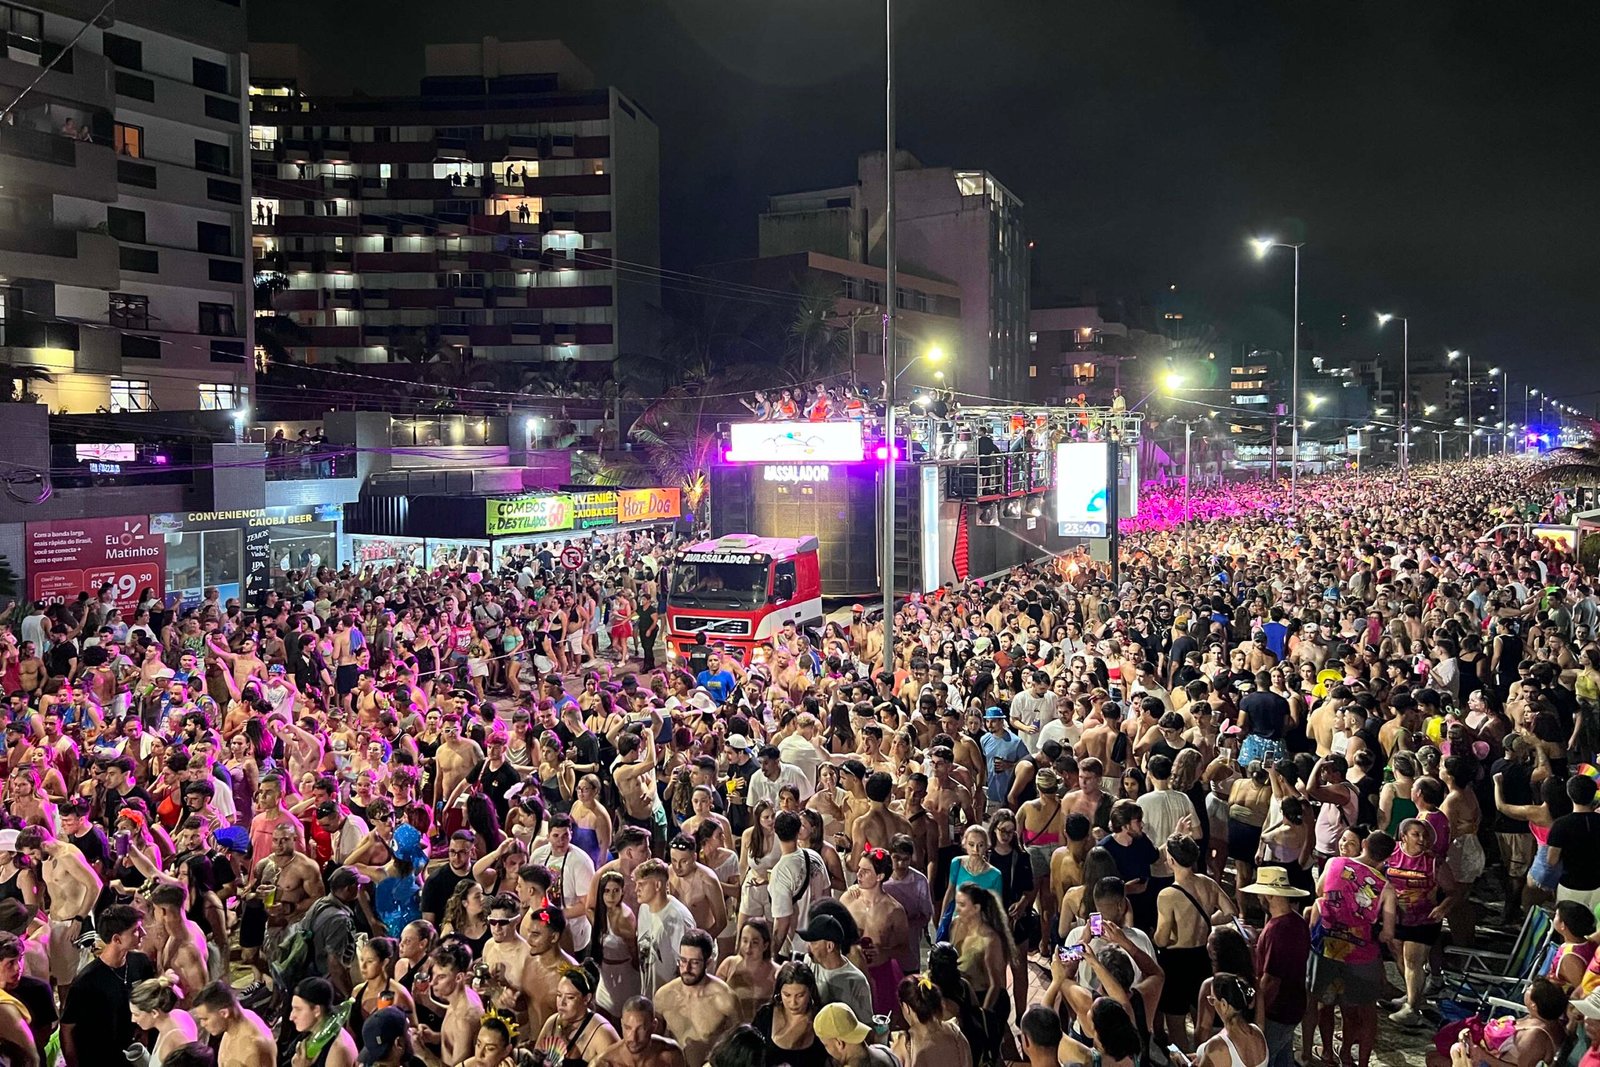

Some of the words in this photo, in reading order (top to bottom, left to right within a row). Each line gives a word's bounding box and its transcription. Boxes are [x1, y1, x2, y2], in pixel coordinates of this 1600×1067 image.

[497, 501, 546, 516] COMBOS
[188, 509, 266, 521] CONVENIENCIA
[249, 517, 286, 526] CAIOBA
[288, 514, 312, 524] BEER
[1064, 523, 1100, 534] 23:40
[105, 534, 119, 545] Eu
[105, 547, 159, 559] Matinhos
[683, 553, 751, 564] AVASSALADOR
[91, 579, 103, 589] R$
